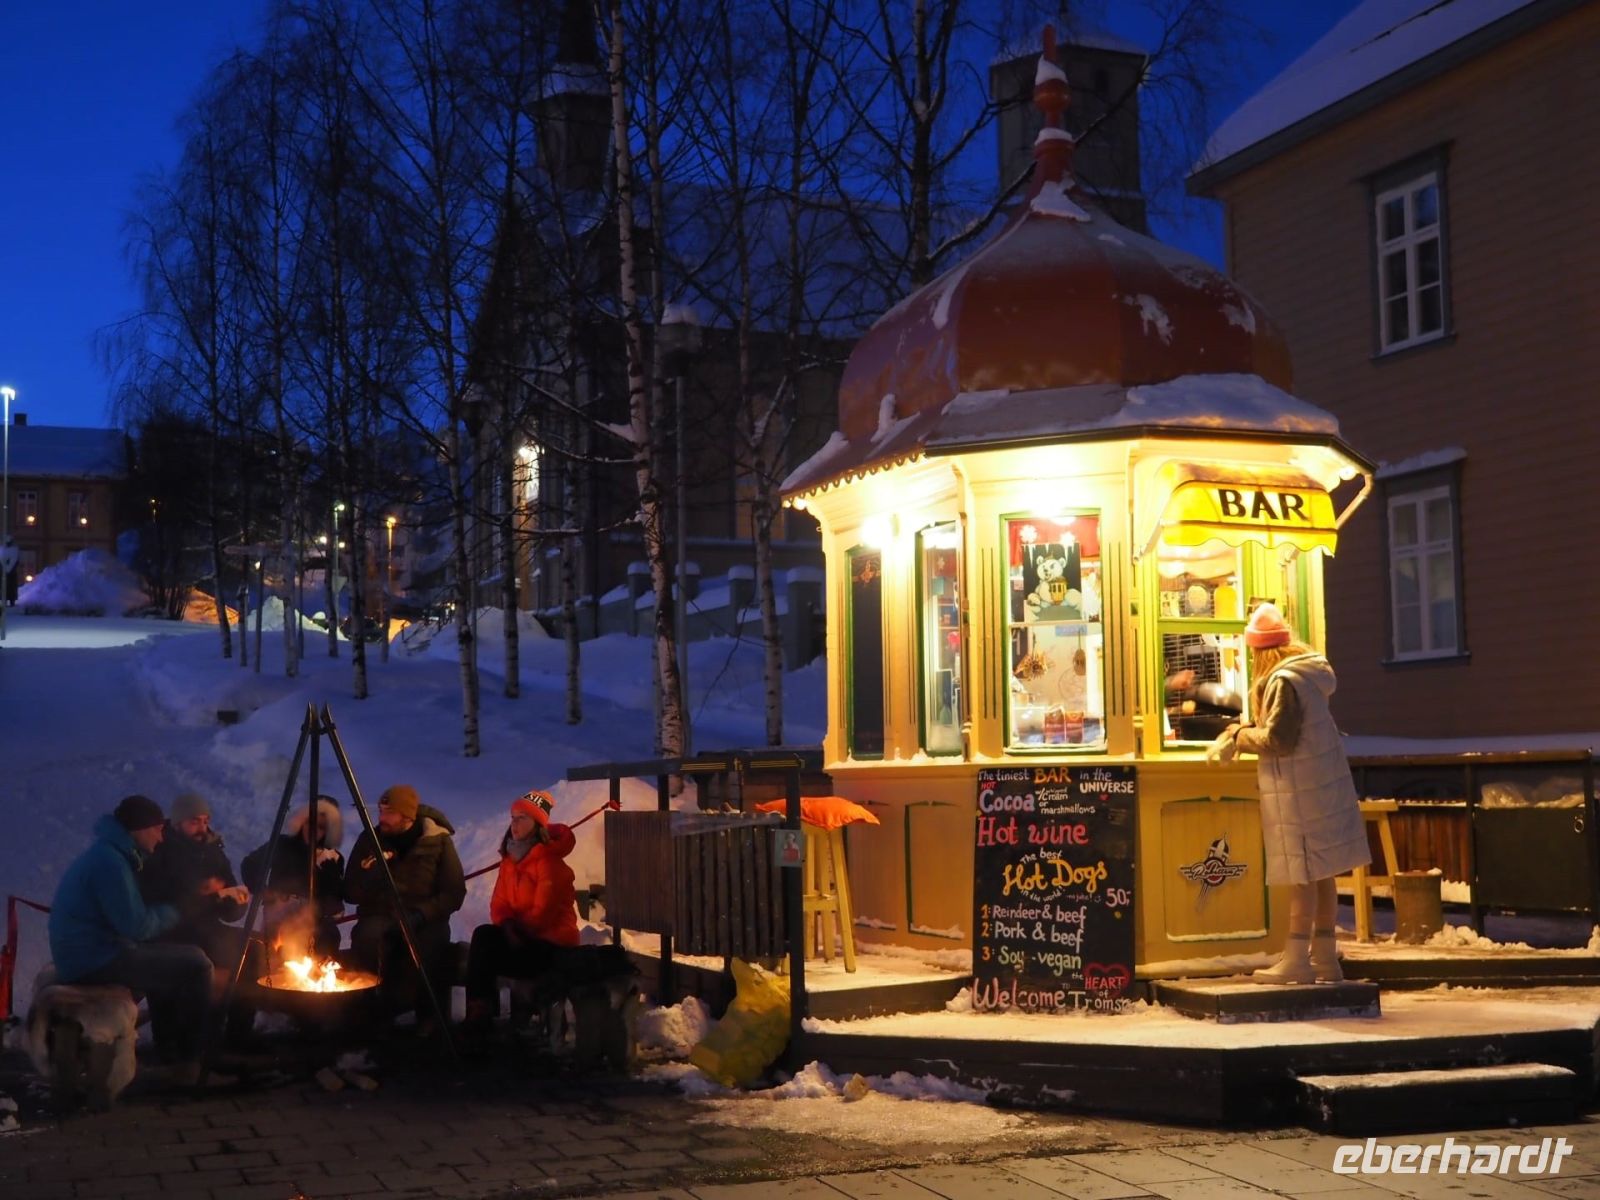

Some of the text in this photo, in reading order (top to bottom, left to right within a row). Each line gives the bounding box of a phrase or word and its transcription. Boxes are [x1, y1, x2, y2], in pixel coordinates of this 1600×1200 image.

[1217, 488, 1312, 521] BAR
[978, 766, 1112, 784] The tiniest BAR in the
[1079, 781, 1135, 794] UNIVERSE
[979, 789, 1035, 813] Cocoa
[1041, 803, 1096, 815] marshmallows
[977, 816, 1089, 847] Hot wine
[1040, 847, 1063, 860] best
[1002, 859, 1108, 896] Hot Dogs
[992, 902, 1042, 920] Reindeer
[1042, 904, 1053, 919] &
[1055, 905, 1087, 929] beef
[994, 921, 1027, 939] Pork
[1032, 921, 1046, 941] &
[1051, 925, 1084, 954] beef
[998, 945, 1025, 970] Soy
[1072, 971, 1084, 980] the
[1084, 976, 1126, 989] HEART
[973, 977, 1066, 1008] Welcome
[1099, 989, 1109, 998] of
